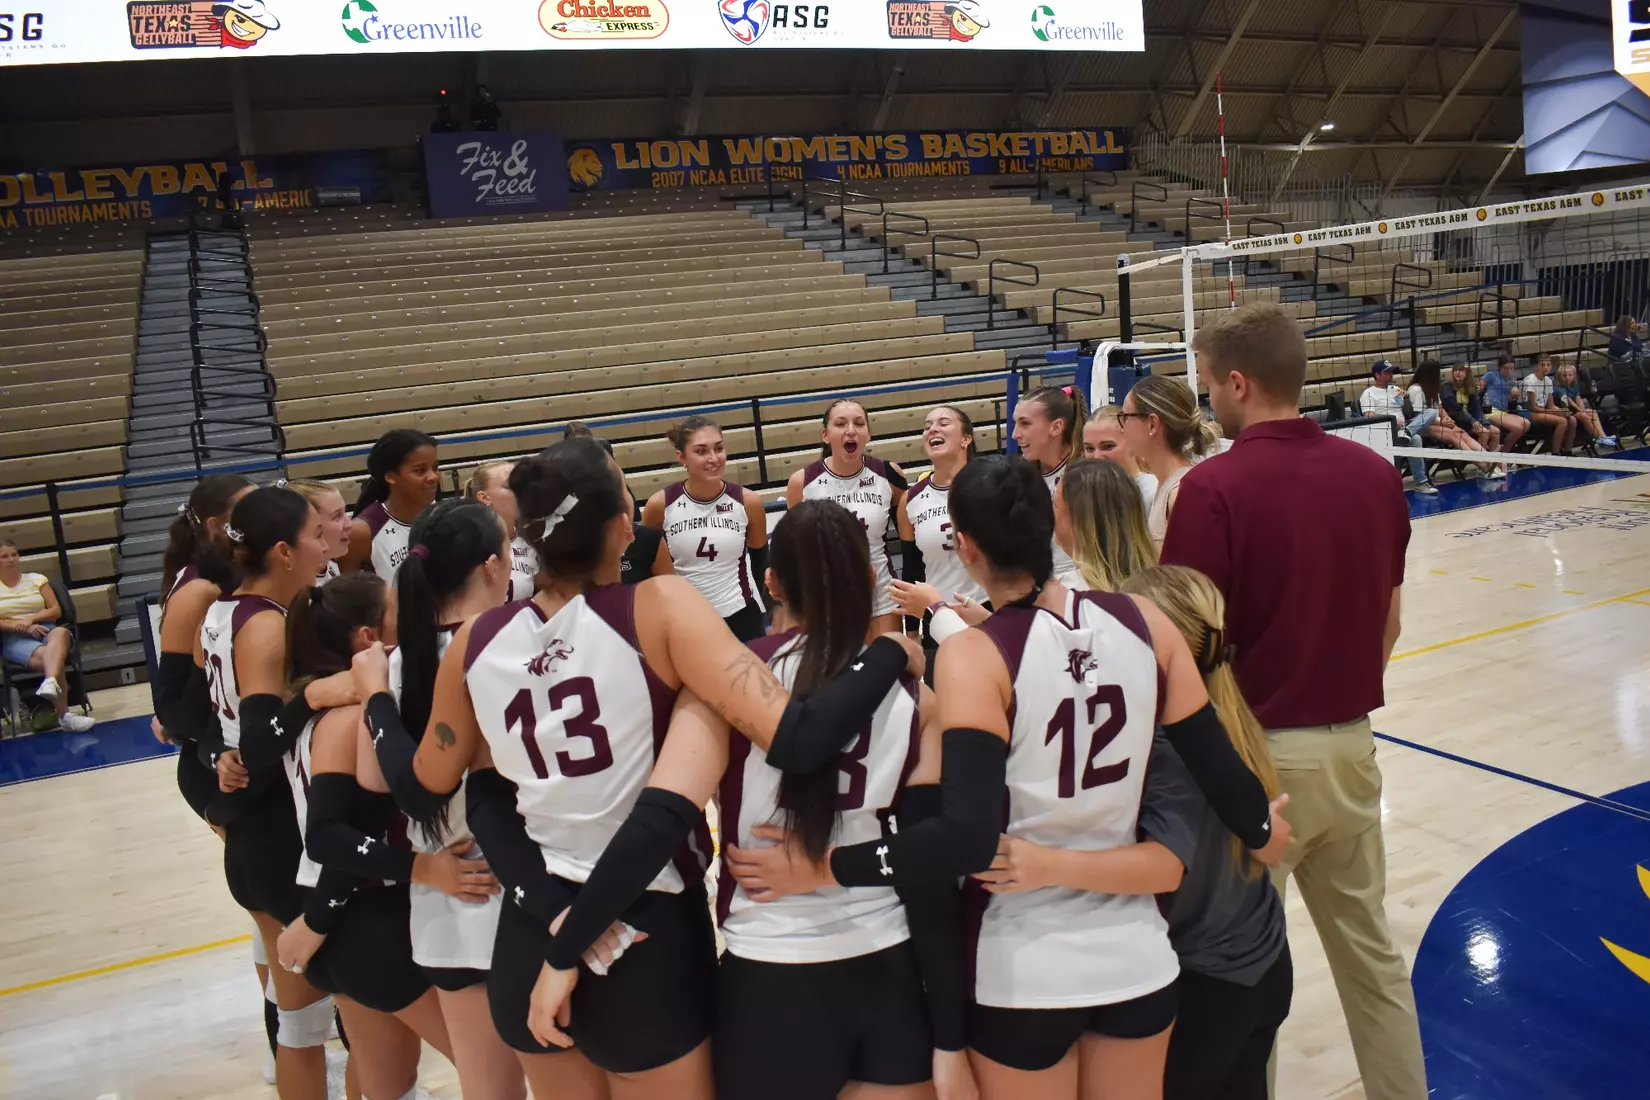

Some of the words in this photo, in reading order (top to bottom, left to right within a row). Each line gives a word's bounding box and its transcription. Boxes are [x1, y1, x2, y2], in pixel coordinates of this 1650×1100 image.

[131, 3, 193, 15] NORTHEAST
[556, 0, 652, 18] Chicken
[773, 5, 829, 29] ASG
[888, 3, 931, 13] NORTHEAST
[0, 13, 43, 41] SG
[133, 15, 192, 33] TEXAS
[363, 16, 483, 42] Greenville
[605, 21, 655, 32] EXPRESS
[889, 12, 931, 26] TEXAS
[1045, 17, 1125, 41] Greenville
[135, 33, 196, 45] GELLYBALL
[890, 26, 933, 37] GELLYBALL
[456, 141, 502, 176] Fix
[503, 139, 529, 177] &
[611, 139, 710, 169] LION
[722, 133, 908, 165] WOMEN'S
[920, 130, 1124, 159] BASKETBALL
[837, 164, 846, 180] 4
[848, 163, 882, 180] NCAA
[886, 160, 970, 178] TOURNAMENTS
[999, 158, 1007, 174] 9
[0, 160, 274, 207] OLLEYBALL
[471, 169, 537, 202] Feed
[651, 170, 685, 188] 2007
[689, 168, 727, 187] NCAA
[730, 166, 764, 184] ELITE
[1615, 189, 1643, 201] EAST
[22, 200, 152, 228] TOURNAMENTS
[1495, 206, 1520, 217] EAST
[1523, 201, 1556, 213] TEXAS
[1560, 197, 1582, 208] A&M
[1395, 220, 1416, 230] EAST
[1418, 216, 1446, 227] TEXAS
[1449, 212, 1468, 223] A&M
[1232, 242, 1250, 250] EAST
[1251, 240, 1272, 248] TEXAS
[1274, 237, 1288, 245] A&M
[1308, 232, 1327, 241] EAST
[1329, 229, 1353, 239] TEXAS
[1355, 226, 1371, 236] A&M
[917, 505, 949, 525] SOUTHER
[670, 517, 708, 536] SOUTHERN
[710, 516, 741, 533] ILLINOIS
[696, 536, 718, 561] 4
[504, 676, 614, 779] 13
[1045, 684, 1130, 798] 12
